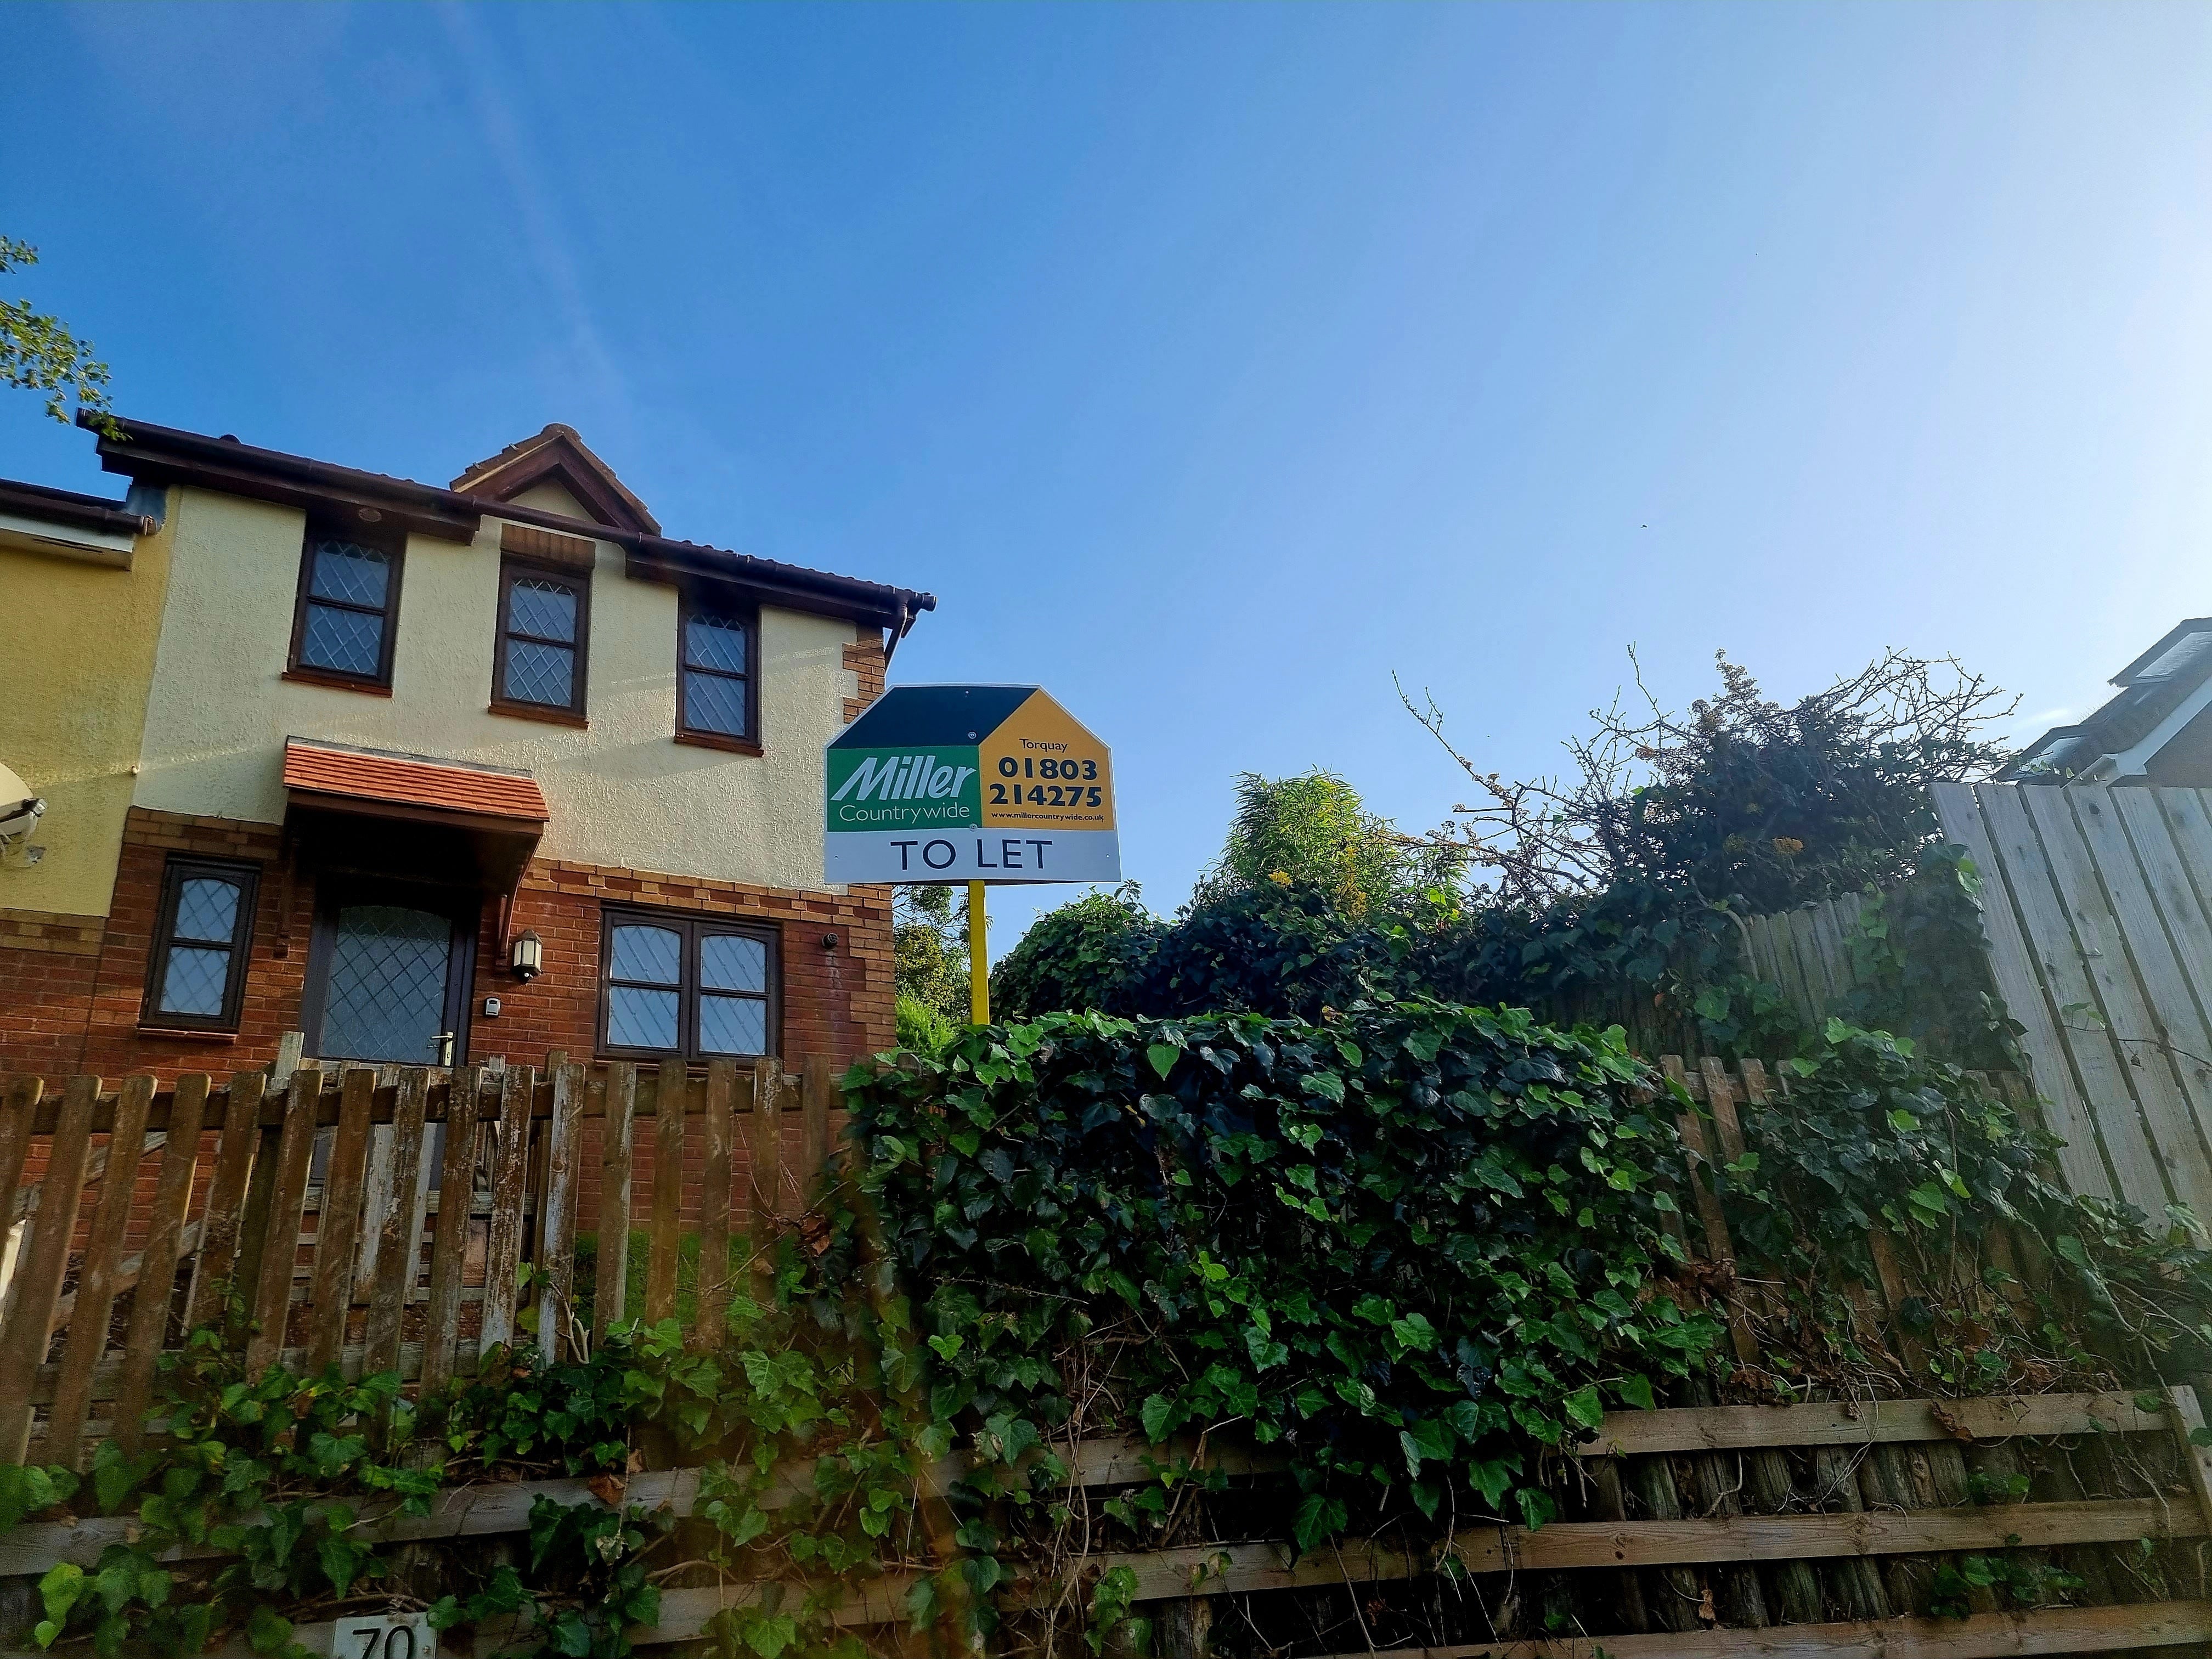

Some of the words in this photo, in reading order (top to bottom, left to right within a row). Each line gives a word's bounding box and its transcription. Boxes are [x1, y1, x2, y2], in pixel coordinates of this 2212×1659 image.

[1019, 738, 1068, 753] Torquay
[830, 755, 977, 801] Miller
[998, 757, 1097, 781] 01803
[989, 783, 1102, 808] 214275
[839, 802, 970, 824] Countrywide
[991, 811, 1104, 822] www.millercountrywide.co.uk
[890, 839, 957, 871] TO
[977, 839, 1053, 870] LET
[352, 1625, 414, 1659] 70
